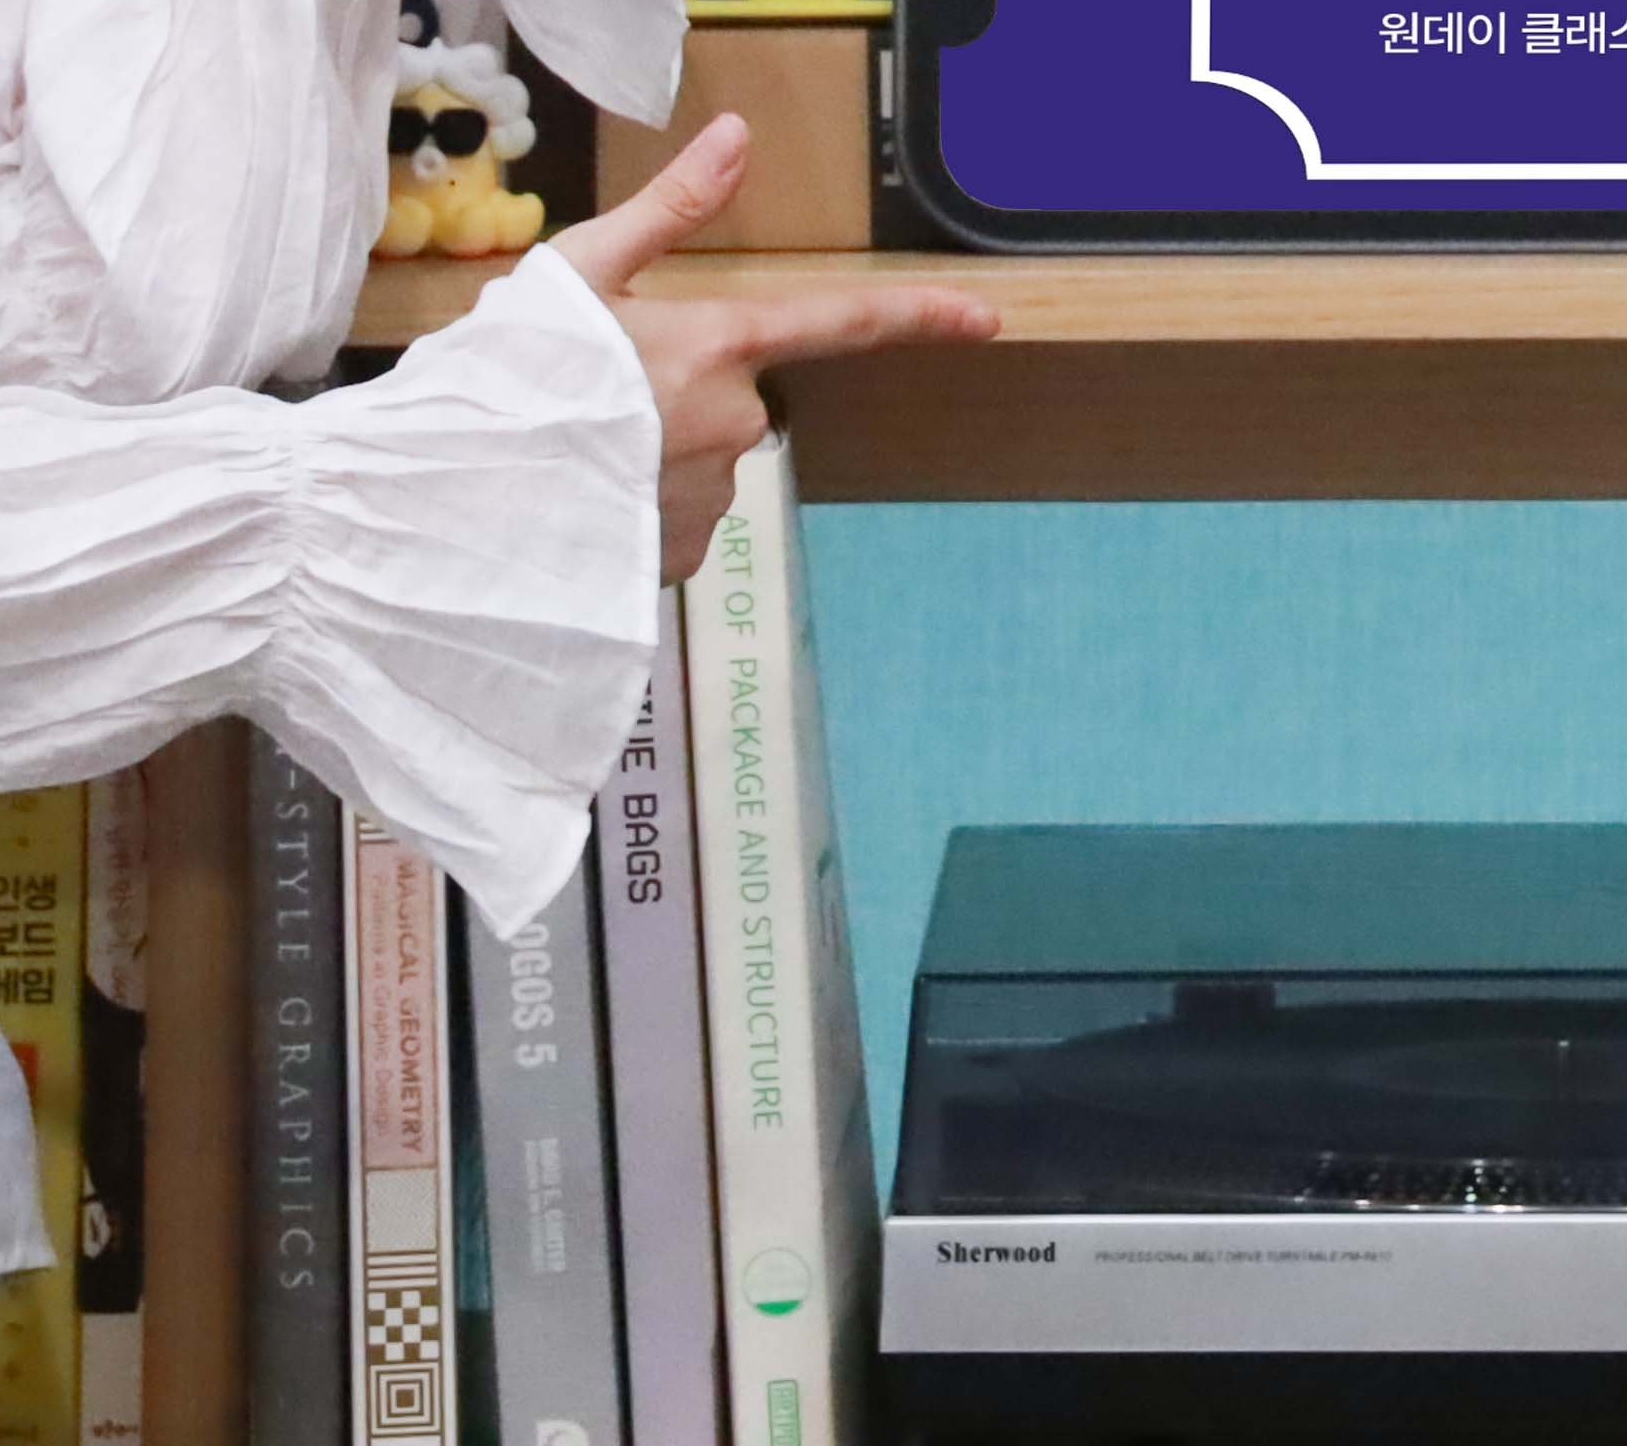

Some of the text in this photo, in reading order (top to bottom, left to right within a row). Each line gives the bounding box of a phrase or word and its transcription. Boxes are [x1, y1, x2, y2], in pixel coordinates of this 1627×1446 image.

[1379, 12, 1505, 54] 원데이
[623, 793, 662, 904] BAGS
[722, 514, 783, 1130] ART OF PACKAGE AND STRUCTURE
[275, 746, 312, 1290] -STYLE GRAPHICS
[509, 922, 558, 1069] OGOS 5
[399, 997, 422, 1154] GEOMETRY
[936, 1241, 1057, 1264] Sherwood
